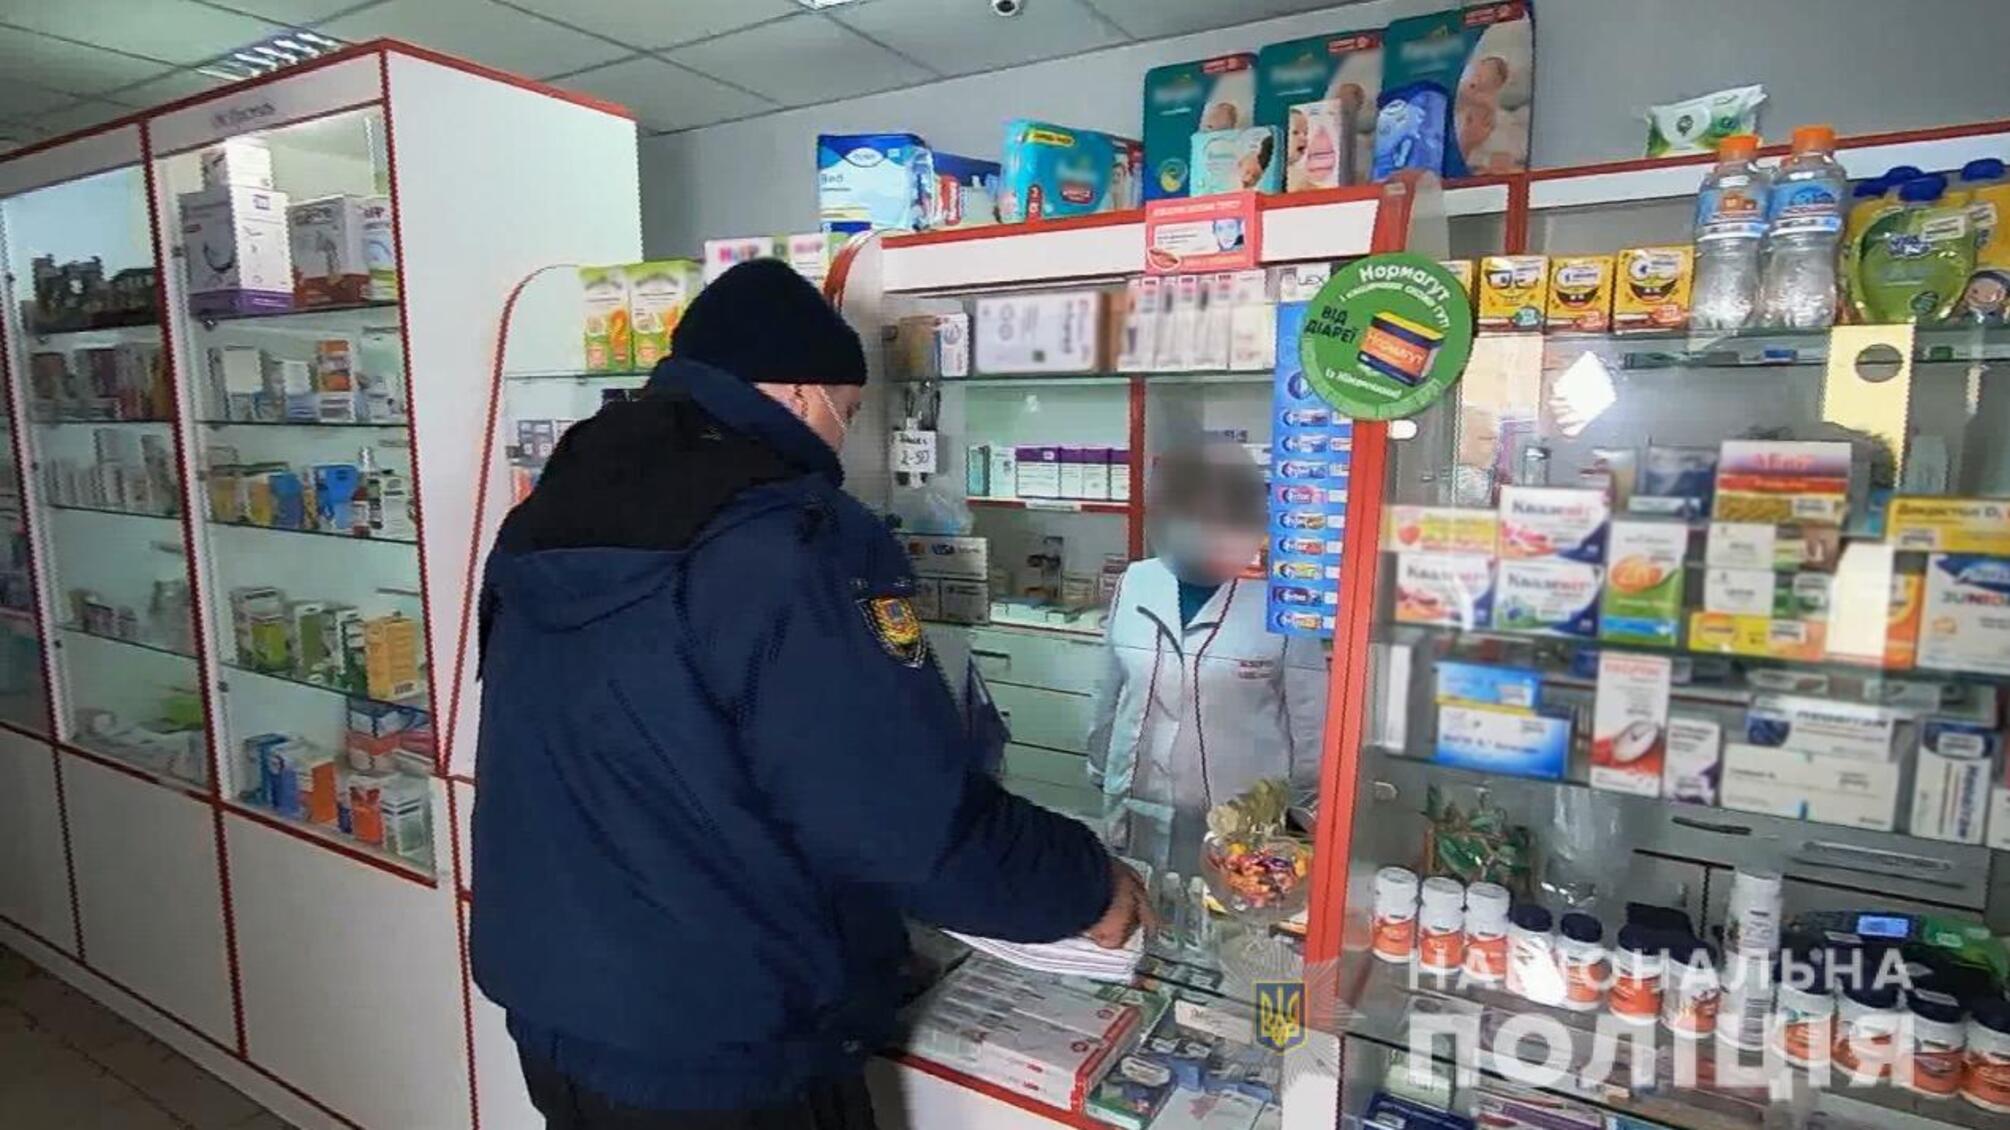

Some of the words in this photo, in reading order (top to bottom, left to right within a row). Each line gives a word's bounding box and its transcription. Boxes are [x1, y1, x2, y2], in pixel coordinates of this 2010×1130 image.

[1358, 264, 1451, 302] Нормагут
[1321, 305, 1349, 327] ВІД
[1304, 320, 1359, 344] ДІАРЕЇ
